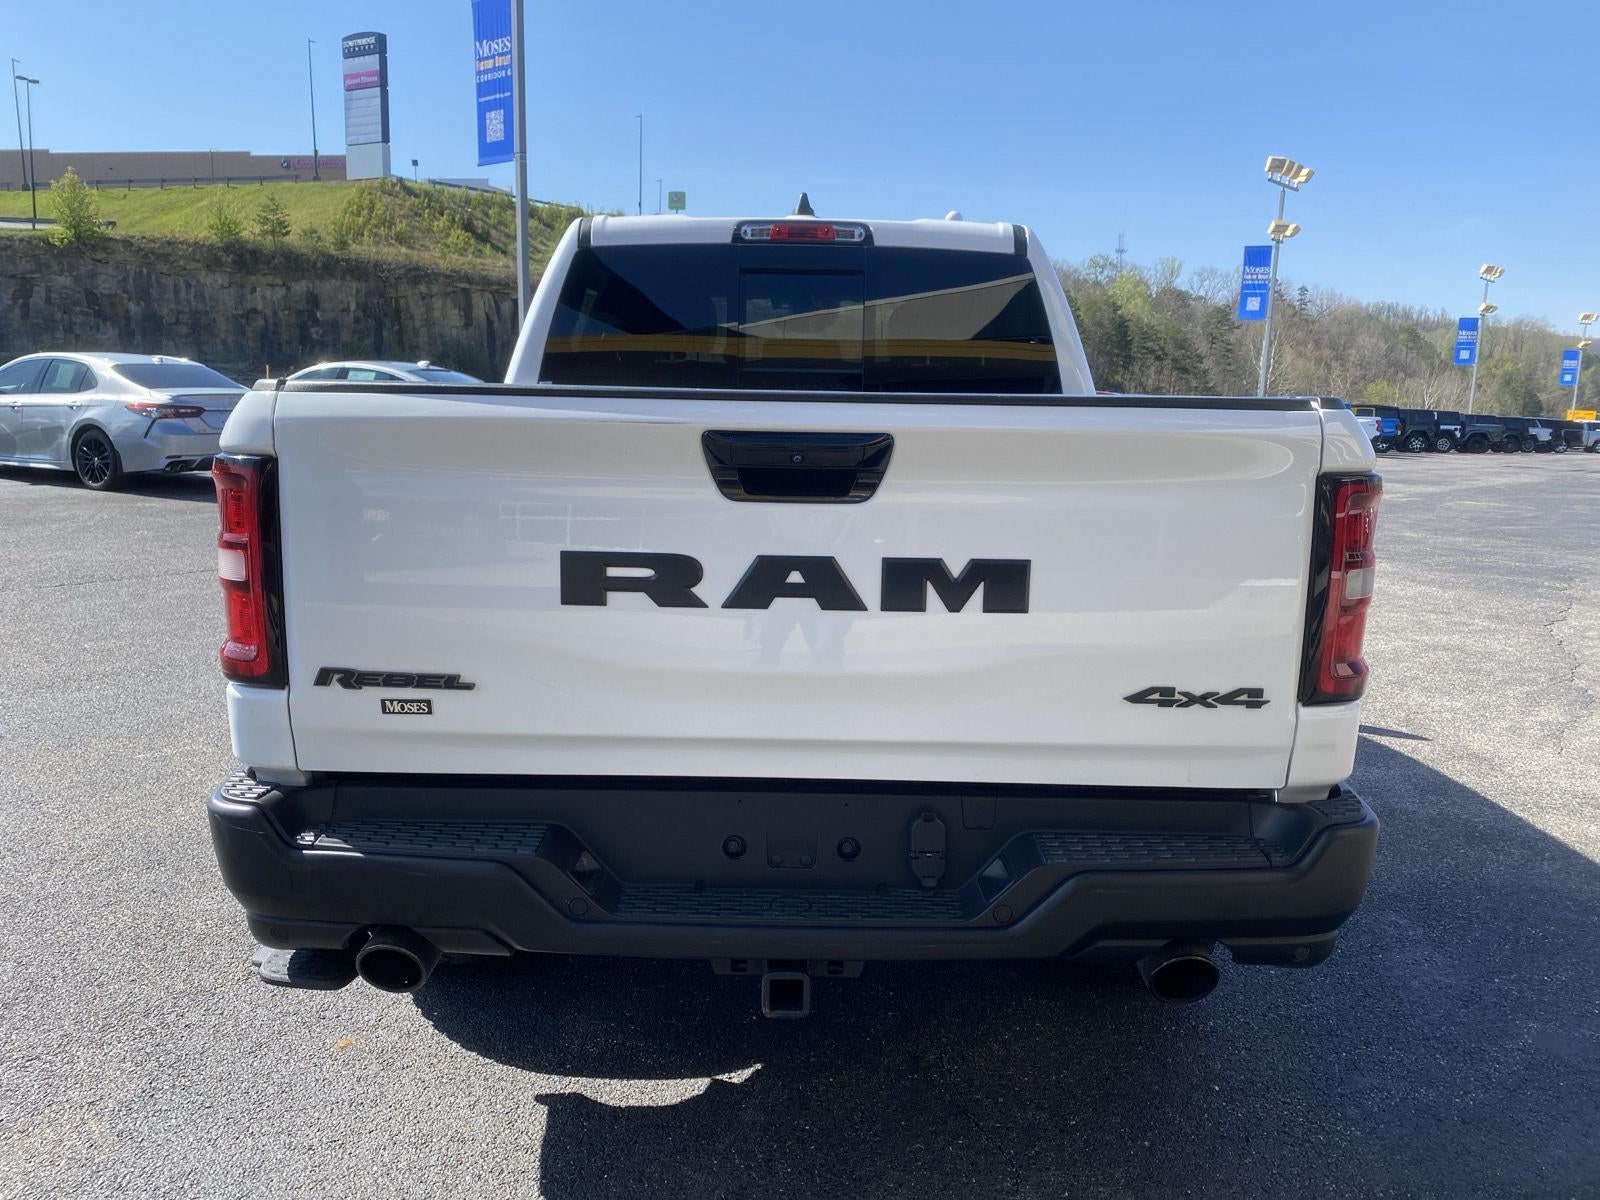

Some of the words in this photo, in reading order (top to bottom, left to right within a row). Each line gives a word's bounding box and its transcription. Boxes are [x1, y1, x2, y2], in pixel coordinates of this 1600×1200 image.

[475, 36, 511, 59] MOSES
[476, 70, 506, 83] CORRIDOR
[1244, 266, 1270, 274] MOSES
[560, 550, 1032, 614] RAM
[313, 666, 476, 691] REBEL
[384, 700, 429, 714] MOSES
[1122, 686, 1271, 709] 4x4
